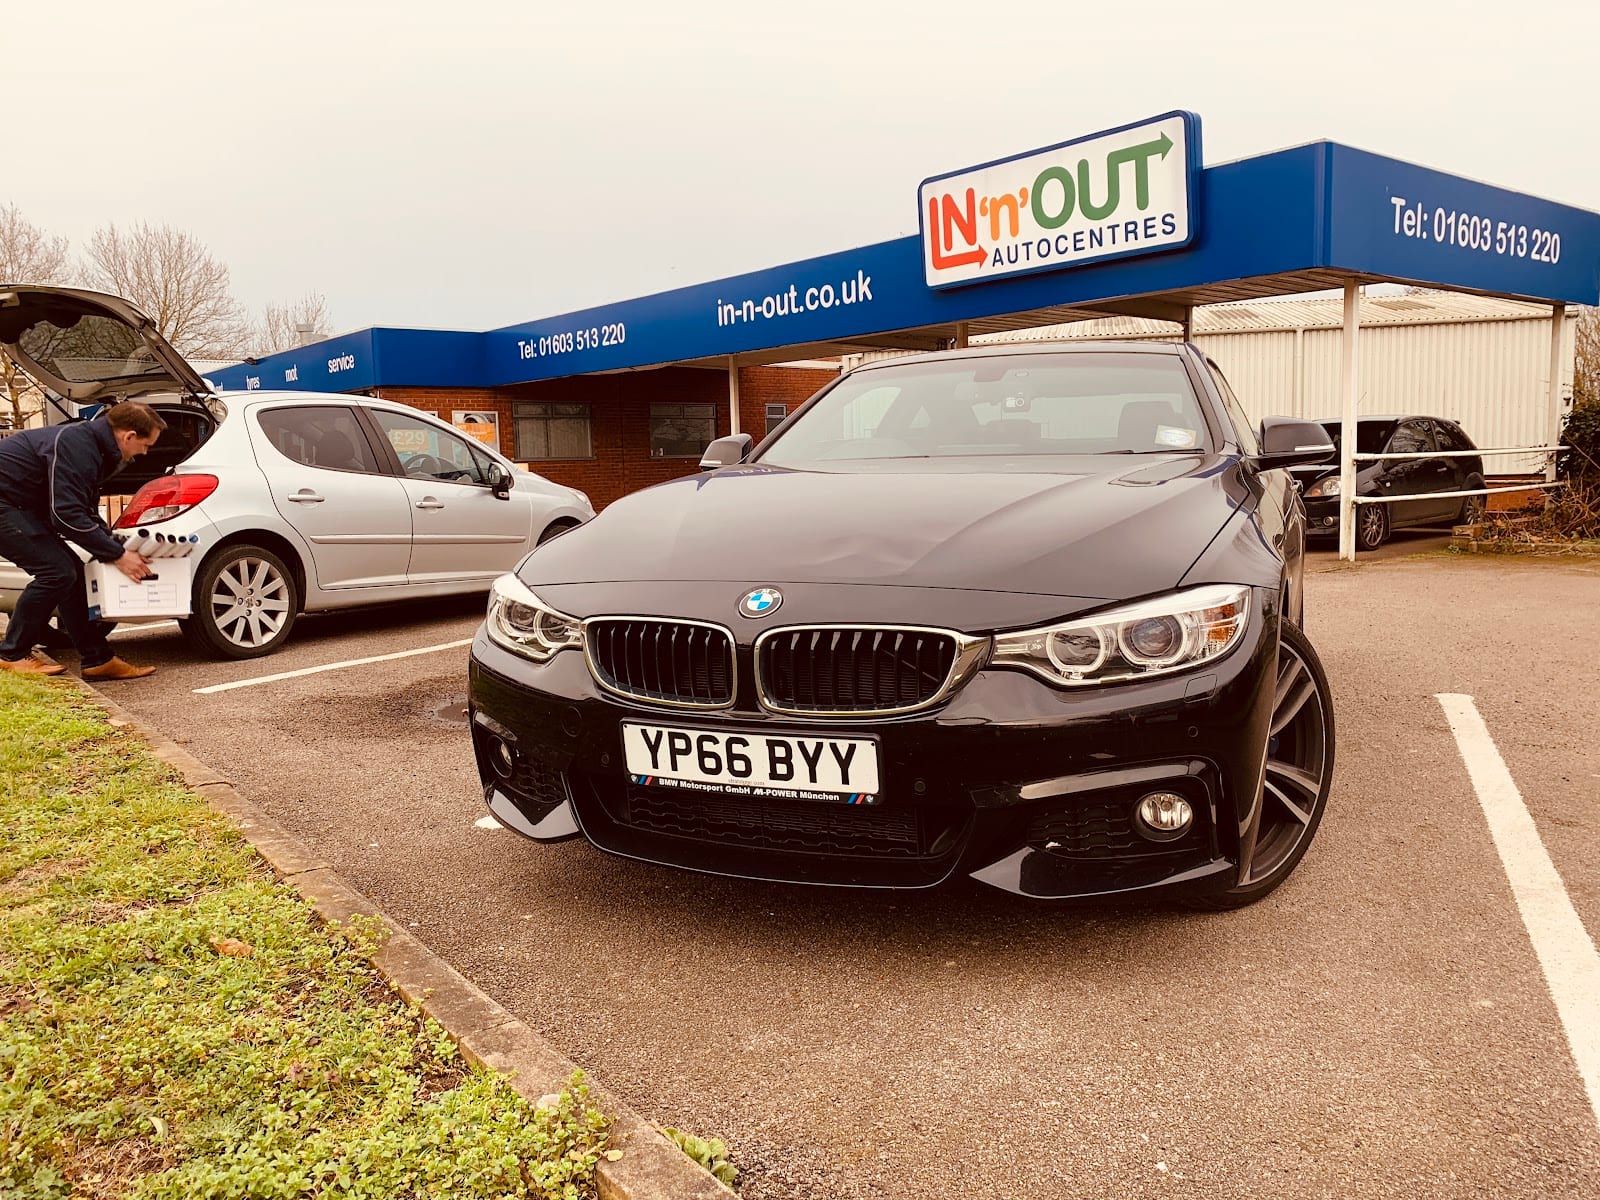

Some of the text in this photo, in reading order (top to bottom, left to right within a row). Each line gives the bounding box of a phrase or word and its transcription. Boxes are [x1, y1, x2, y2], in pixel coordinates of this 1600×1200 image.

[992, 212, 1177, 268] AUTOCENTRES
[1390, 196, 1561, 264] Tel: 01603 513 220
[717, 269, 873, 327] in-n-out.co.uk
[518, 322, 625, 360] Tel: 01603 513 220
[285, 364, 299, 382] mot
[327, 352, 355, 374] service
[393, 431, 425, 445] £29
[640, 728, 856, 785] YP66 BYY
[658, 777, 678, 787] BMW
[679, 779, 724, 793] Motorsport
[725, 784, 751, 795] GmbH
[752, 787, 798, 799] M-POWER
[799, 790, 840, 801] München
